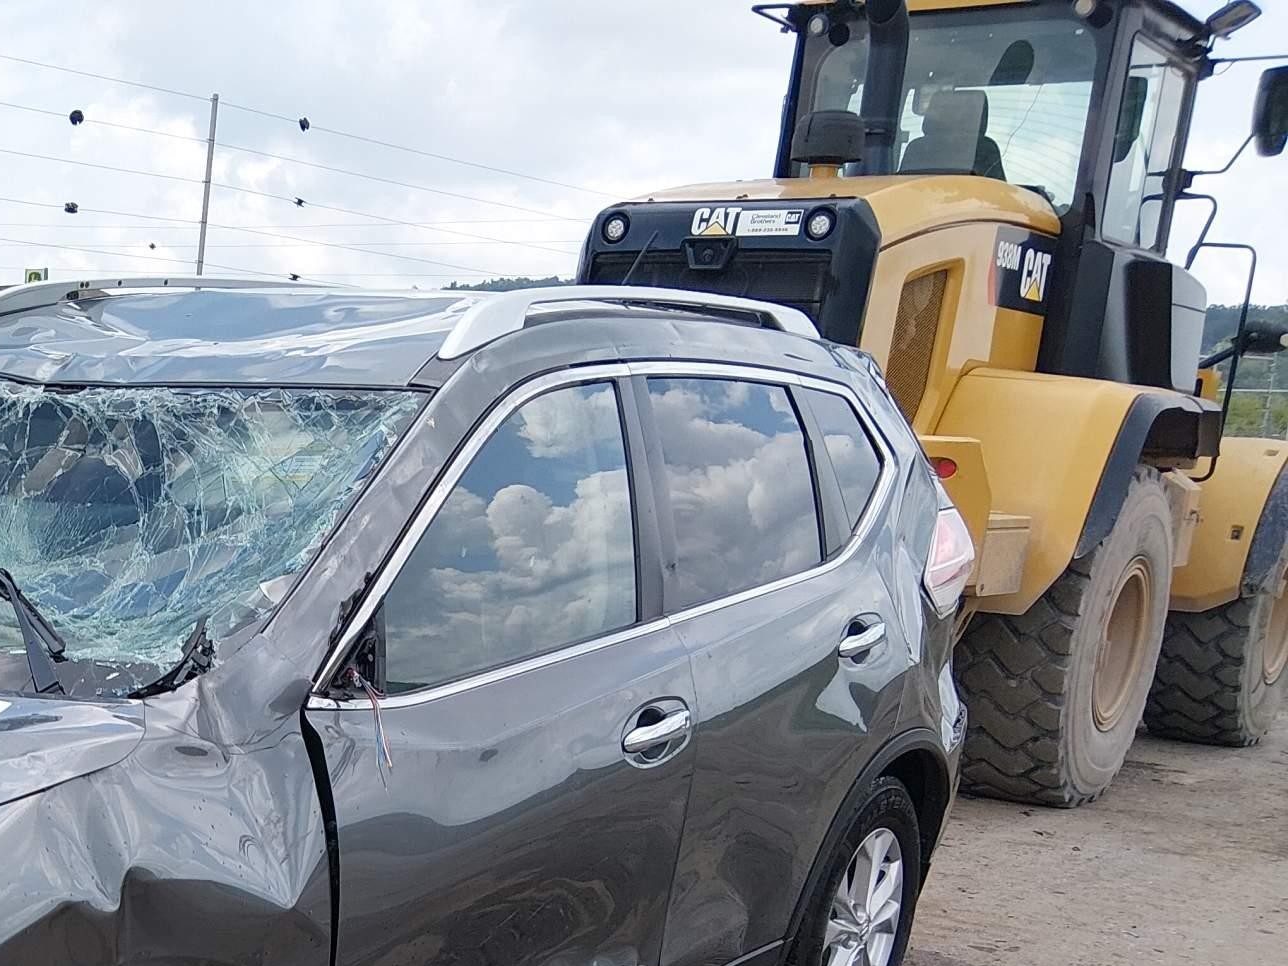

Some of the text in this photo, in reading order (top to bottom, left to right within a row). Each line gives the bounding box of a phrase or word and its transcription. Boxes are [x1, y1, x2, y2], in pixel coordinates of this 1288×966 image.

[691, 207, 742, 235] CAT
[786, 213, 800, 222] CAT
[997, 241, 1022, 271] 938M
[1020, 248, 1052, 302] CAT
